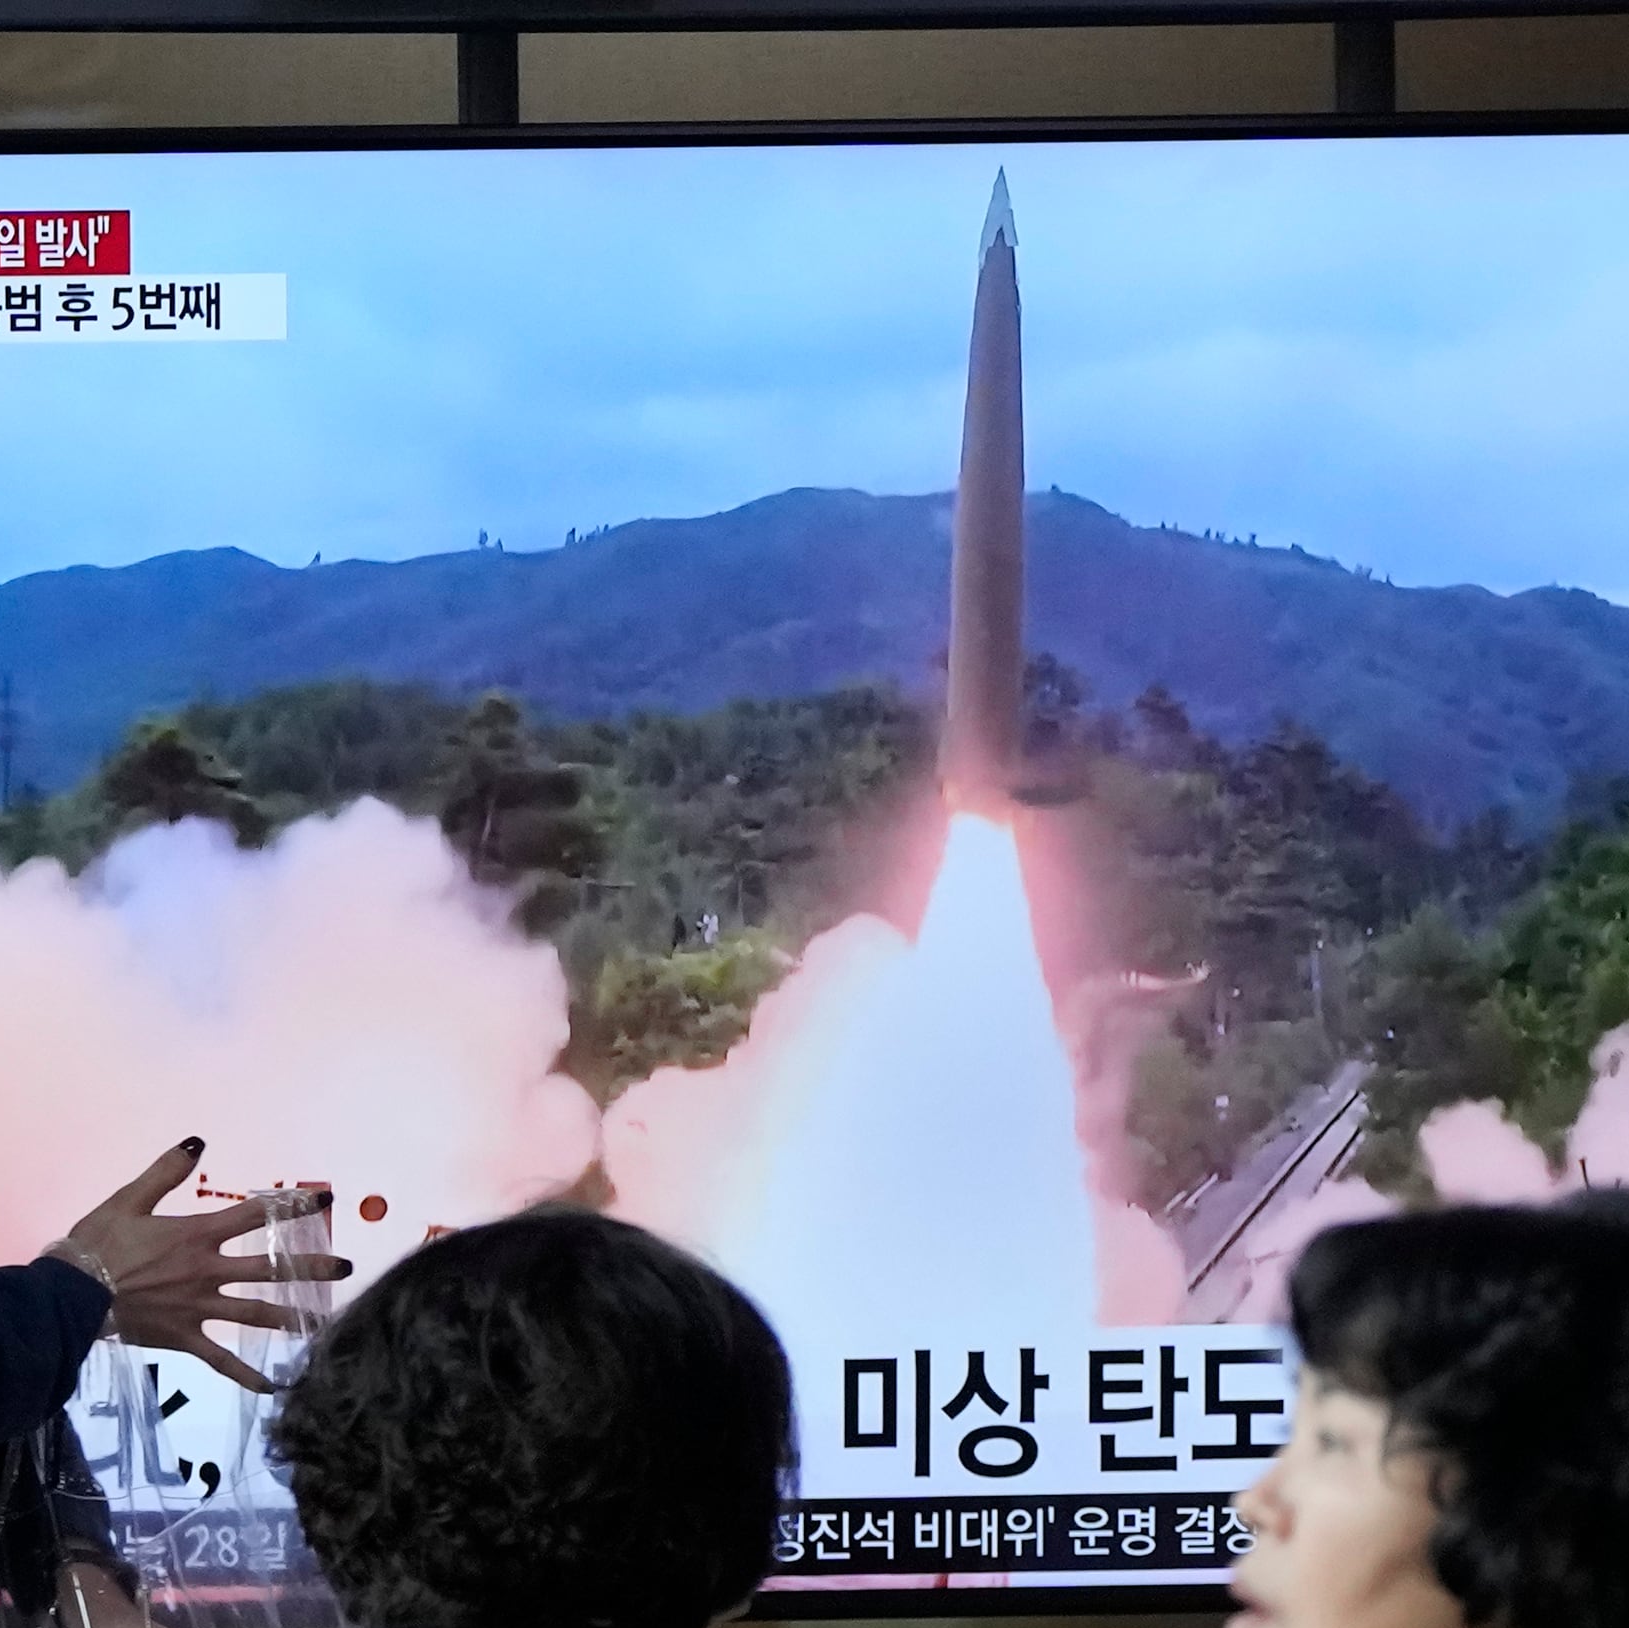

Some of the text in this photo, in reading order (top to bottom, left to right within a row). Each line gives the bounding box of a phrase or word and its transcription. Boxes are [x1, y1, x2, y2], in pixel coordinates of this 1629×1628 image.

[36, 215, 109, 268] 발사"
[55, 282, 98, 331] 후
[112, 282, 222, 331] 5번째
[843, 1347, 1050, 1478] 미상
[1068, 1505, 1157, 1556] 운명
